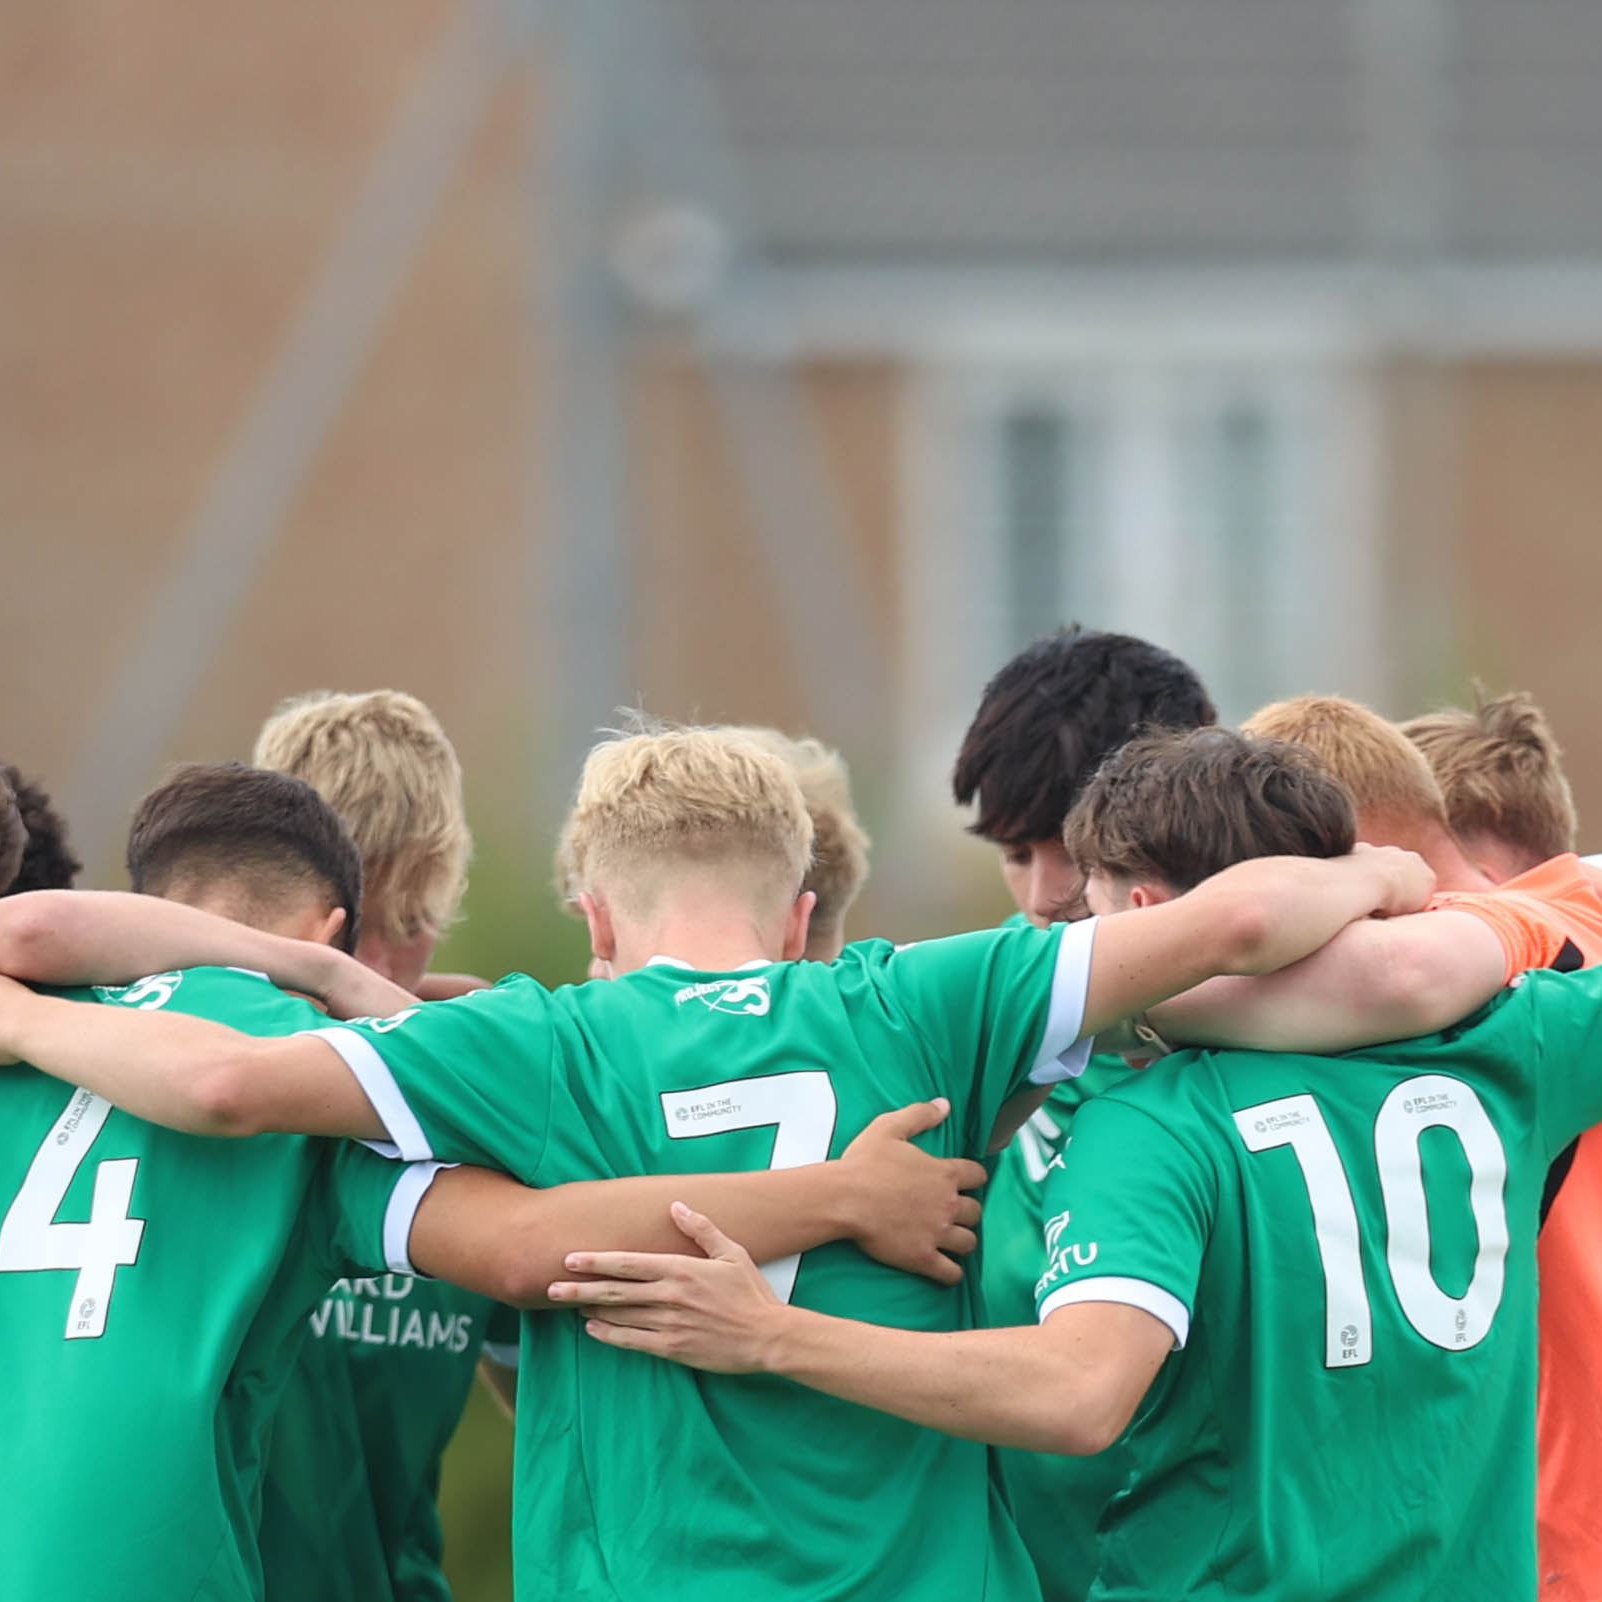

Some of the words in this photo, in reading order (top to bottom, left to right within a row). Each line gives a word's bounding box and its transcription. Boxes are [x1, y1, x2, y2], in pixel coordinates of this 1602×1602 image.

[659, 1070, 838, 1305] 7
[1232, 1073, 1510, 1369] 10
[1342, 1348, 1359, 1359] EFL
